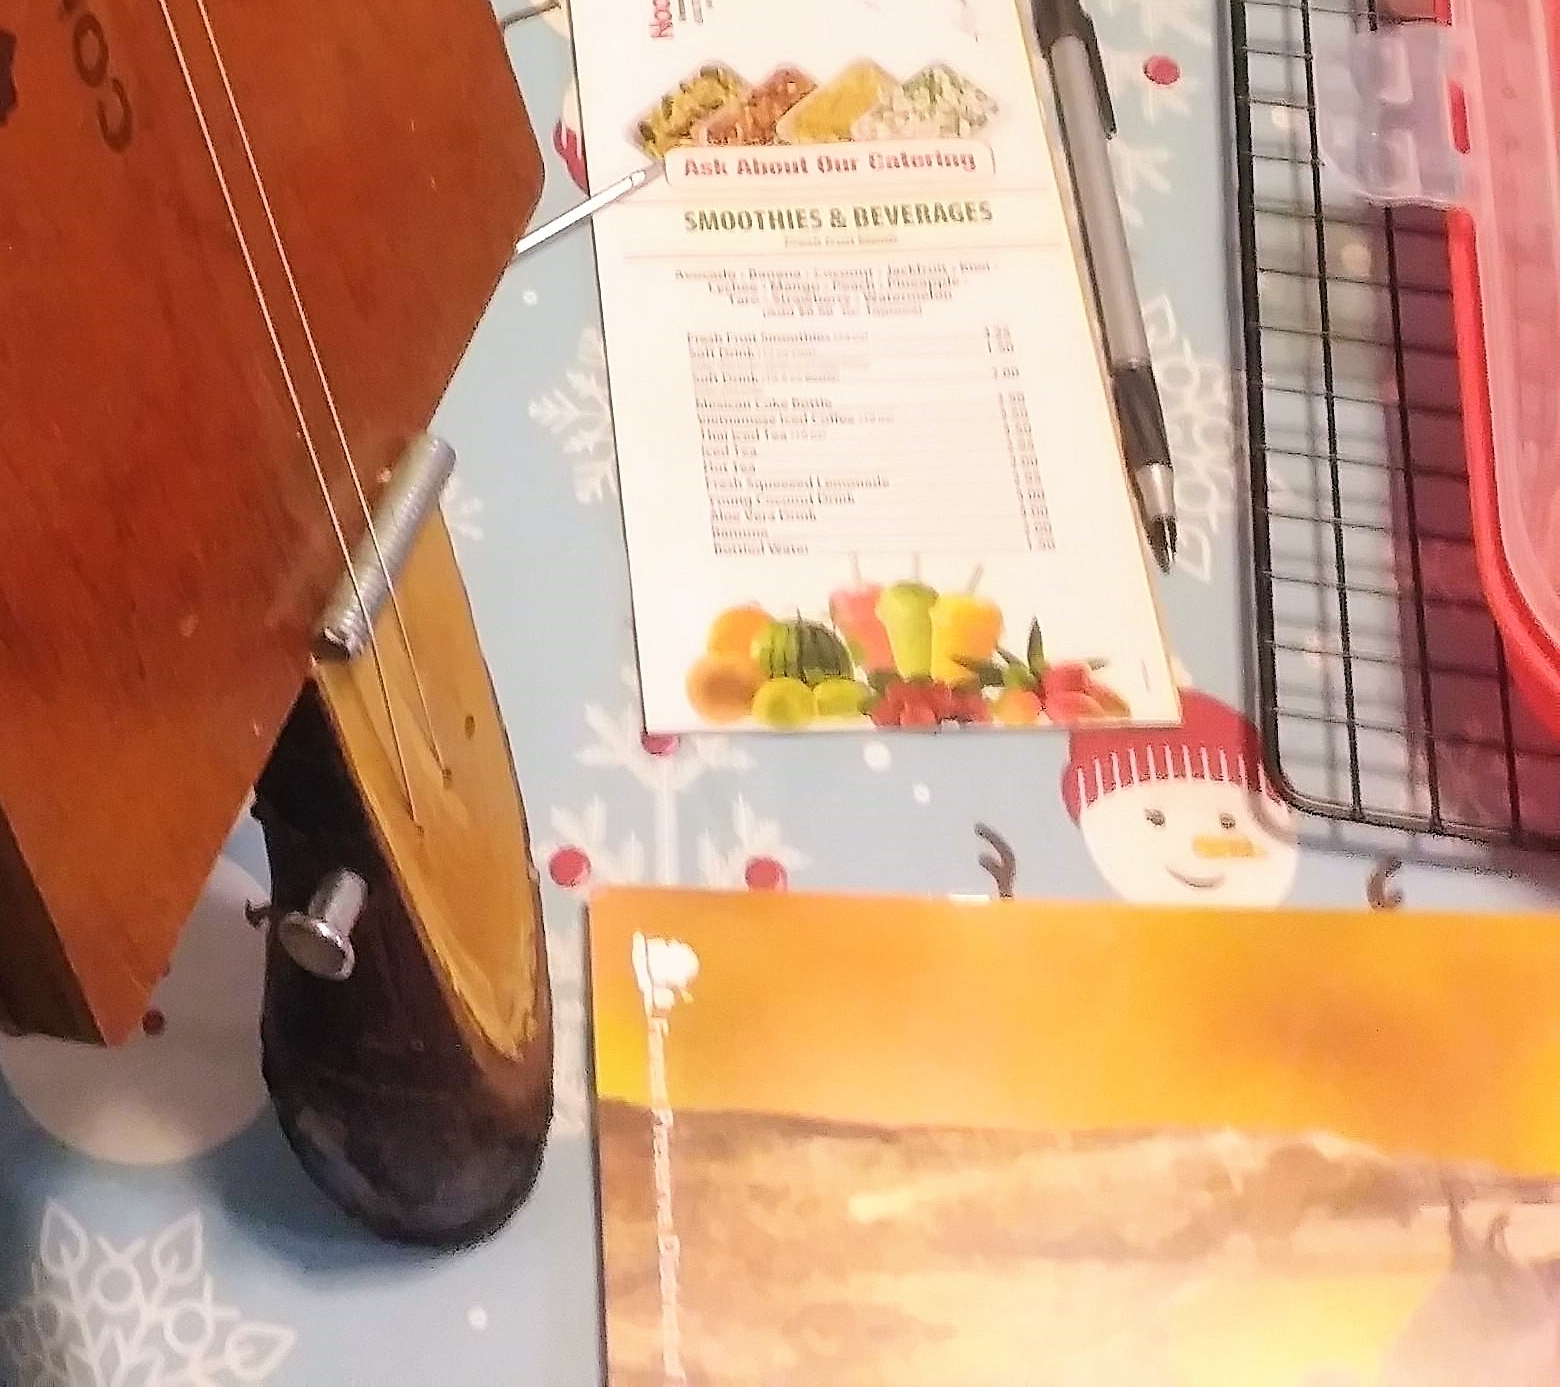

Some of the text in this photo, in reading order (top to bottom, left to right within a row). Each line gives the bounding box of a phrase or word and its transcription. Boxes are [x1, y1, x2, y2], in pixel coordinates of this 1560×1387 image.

[684, 148, 978, 177] Ask About Our Catering
[683, 200, 994, 233] SMOOTHIES & BEVERAGES
